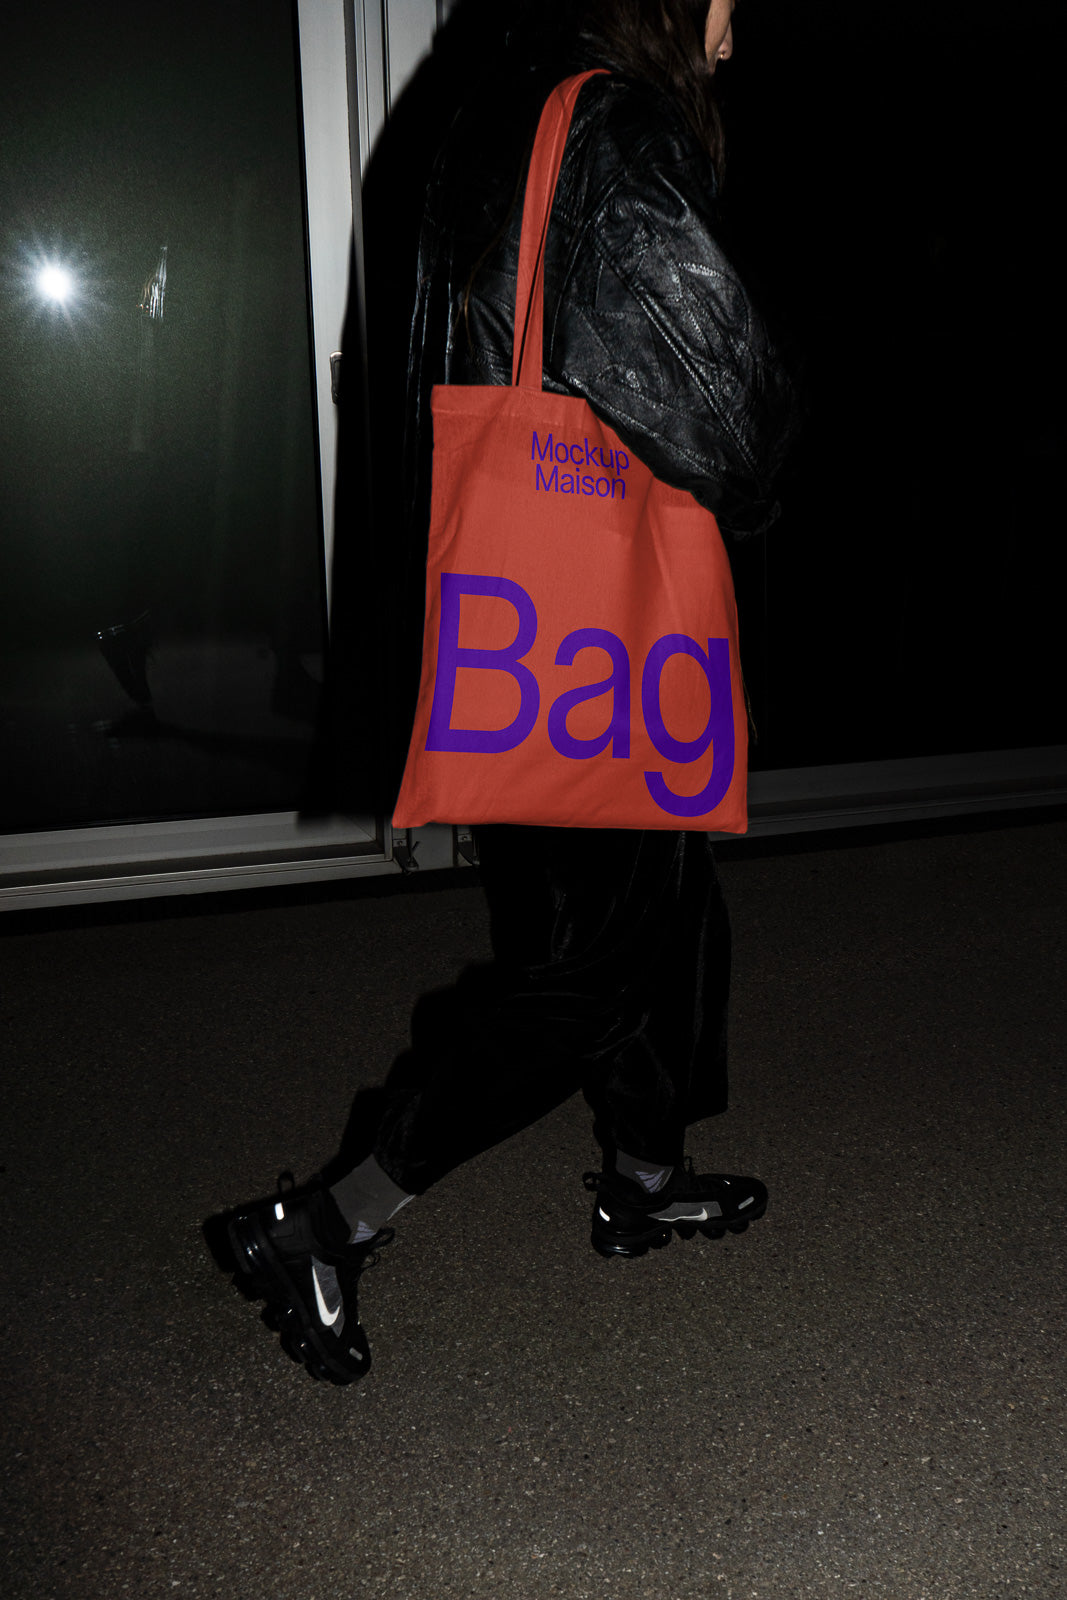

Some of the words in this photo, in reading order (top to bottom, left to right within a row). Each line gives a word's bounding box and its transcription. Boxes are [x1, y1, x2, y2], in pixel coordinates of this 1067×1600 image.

[531, 431, 629, 476] Mockup
[535, 463, 626, 499] Maison
[425, 572, 735, 818] Bag
